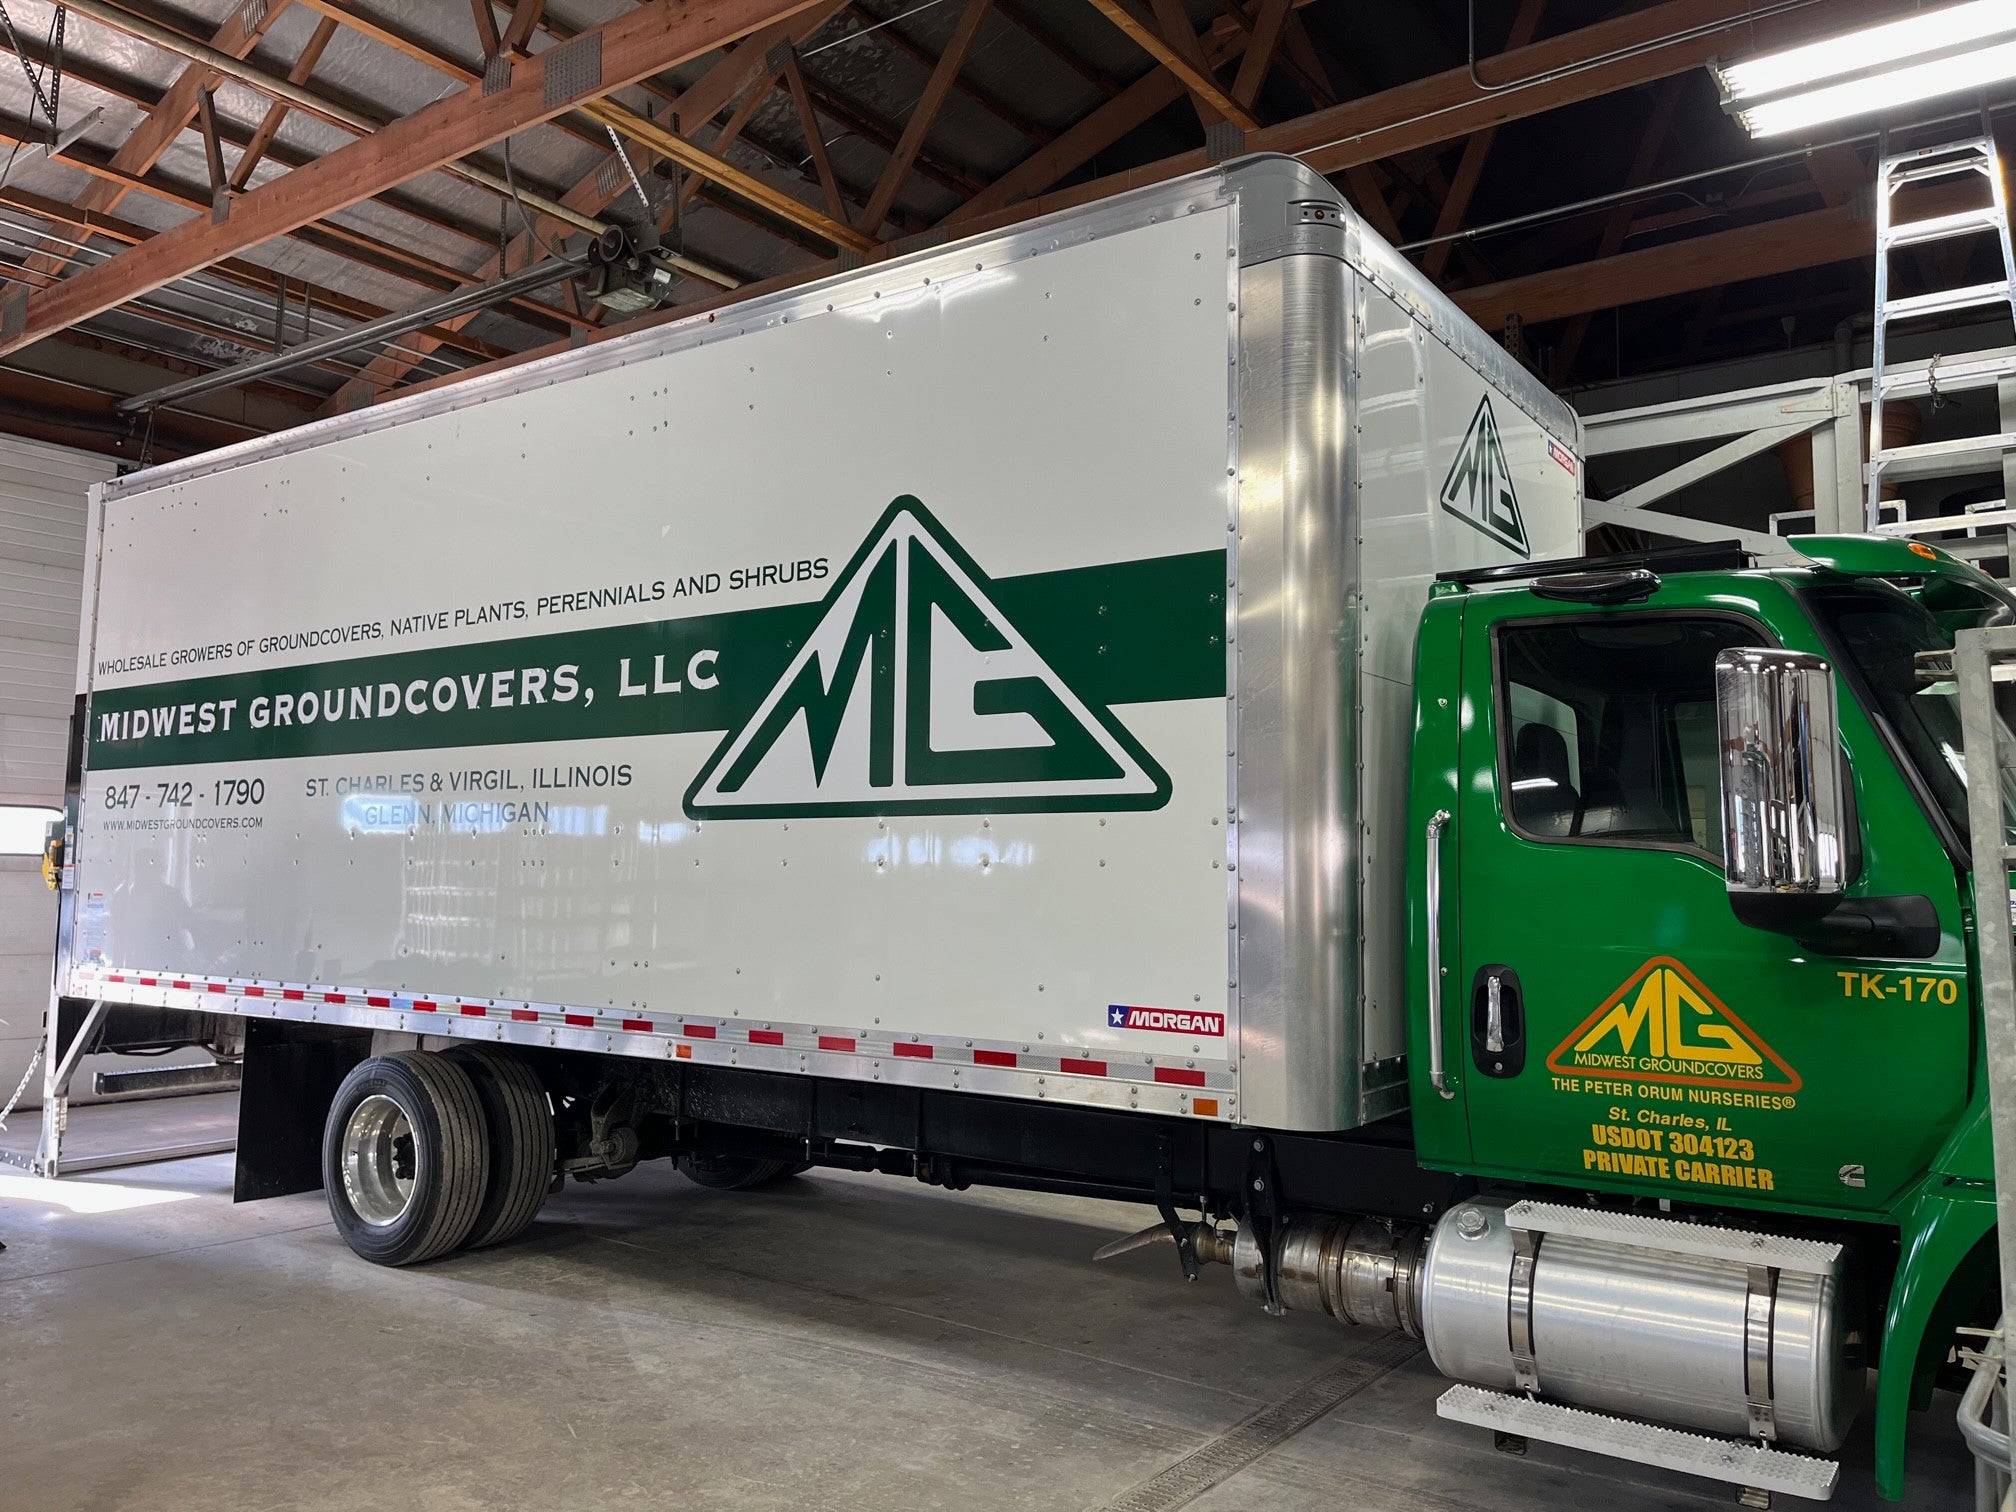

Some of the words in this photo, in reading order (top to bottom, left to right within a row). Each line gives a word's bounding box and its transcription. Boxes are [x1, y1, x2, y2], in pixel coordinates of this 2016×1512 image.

[98, 653, 167, 676] WHOLESALE
[170, 643, 233, 665] GROWERS
[236, 640, 255, 656] OF
[258, 622, 385, 653] GROUNDCOVERS,
[390, 611, 449, 636] NATIVE
[454, 600, 529, 627] PLANTS,
[536, 581, 666, 617] PERENNIALS
[672, 573, 721, 598] AND
[729, 557, 830, 590] SHRUBS
[97, 698, 238, 743] MIDWEST
[249, 664, 595, 730] GROUNDCOVERS,
[618, 649, 720, 698] LLC
[104, 784, 141, 809] 847
[157, 781, 193, 807] 742
[214, 777, 266, 806] 1790
[305, 778, 331, 797] ST.
[335, 773, 425, 794] CHARLES
[430, 774, 443, 793] &
[449, 768, 525, 792] VIRGIL,
[532, 764, 633, 789] ILLINOIS
[102, 816, 264, 831] WWW.MIDWESTGROUNDCOVERS.COM
[365, 804, 436, 826] GLENN,
[444, 801, 549, 825] MICHIGAN
[1836, 970, 1958, 1006] TK-170
[1129, 1010, 1220, 1033] MORGAN
[1574, 1052, 1636, 1071] MIDWEST
[1639, 1059, 1764, 1081] GROUNDCOVERS
[1551, 1077, 1580, 1093] THE
[1584, 1081, 1633, 1097] PETER
[1638, 1085, 1684, 1102] ORUM
[1608, 1106, 1631, 1122] St.
[1636, 1109, 1710, 1132] Charles,
[1715, 1116, 1733, 1132] IL
[1592, 1124, 1664, 1152] USDOT
[1669, 1132, 1755, 1162] 304123
[1583, 1149, 1671, 1180] PRIVATE
[1677, 1160, 1775, 1191] CARRIER
